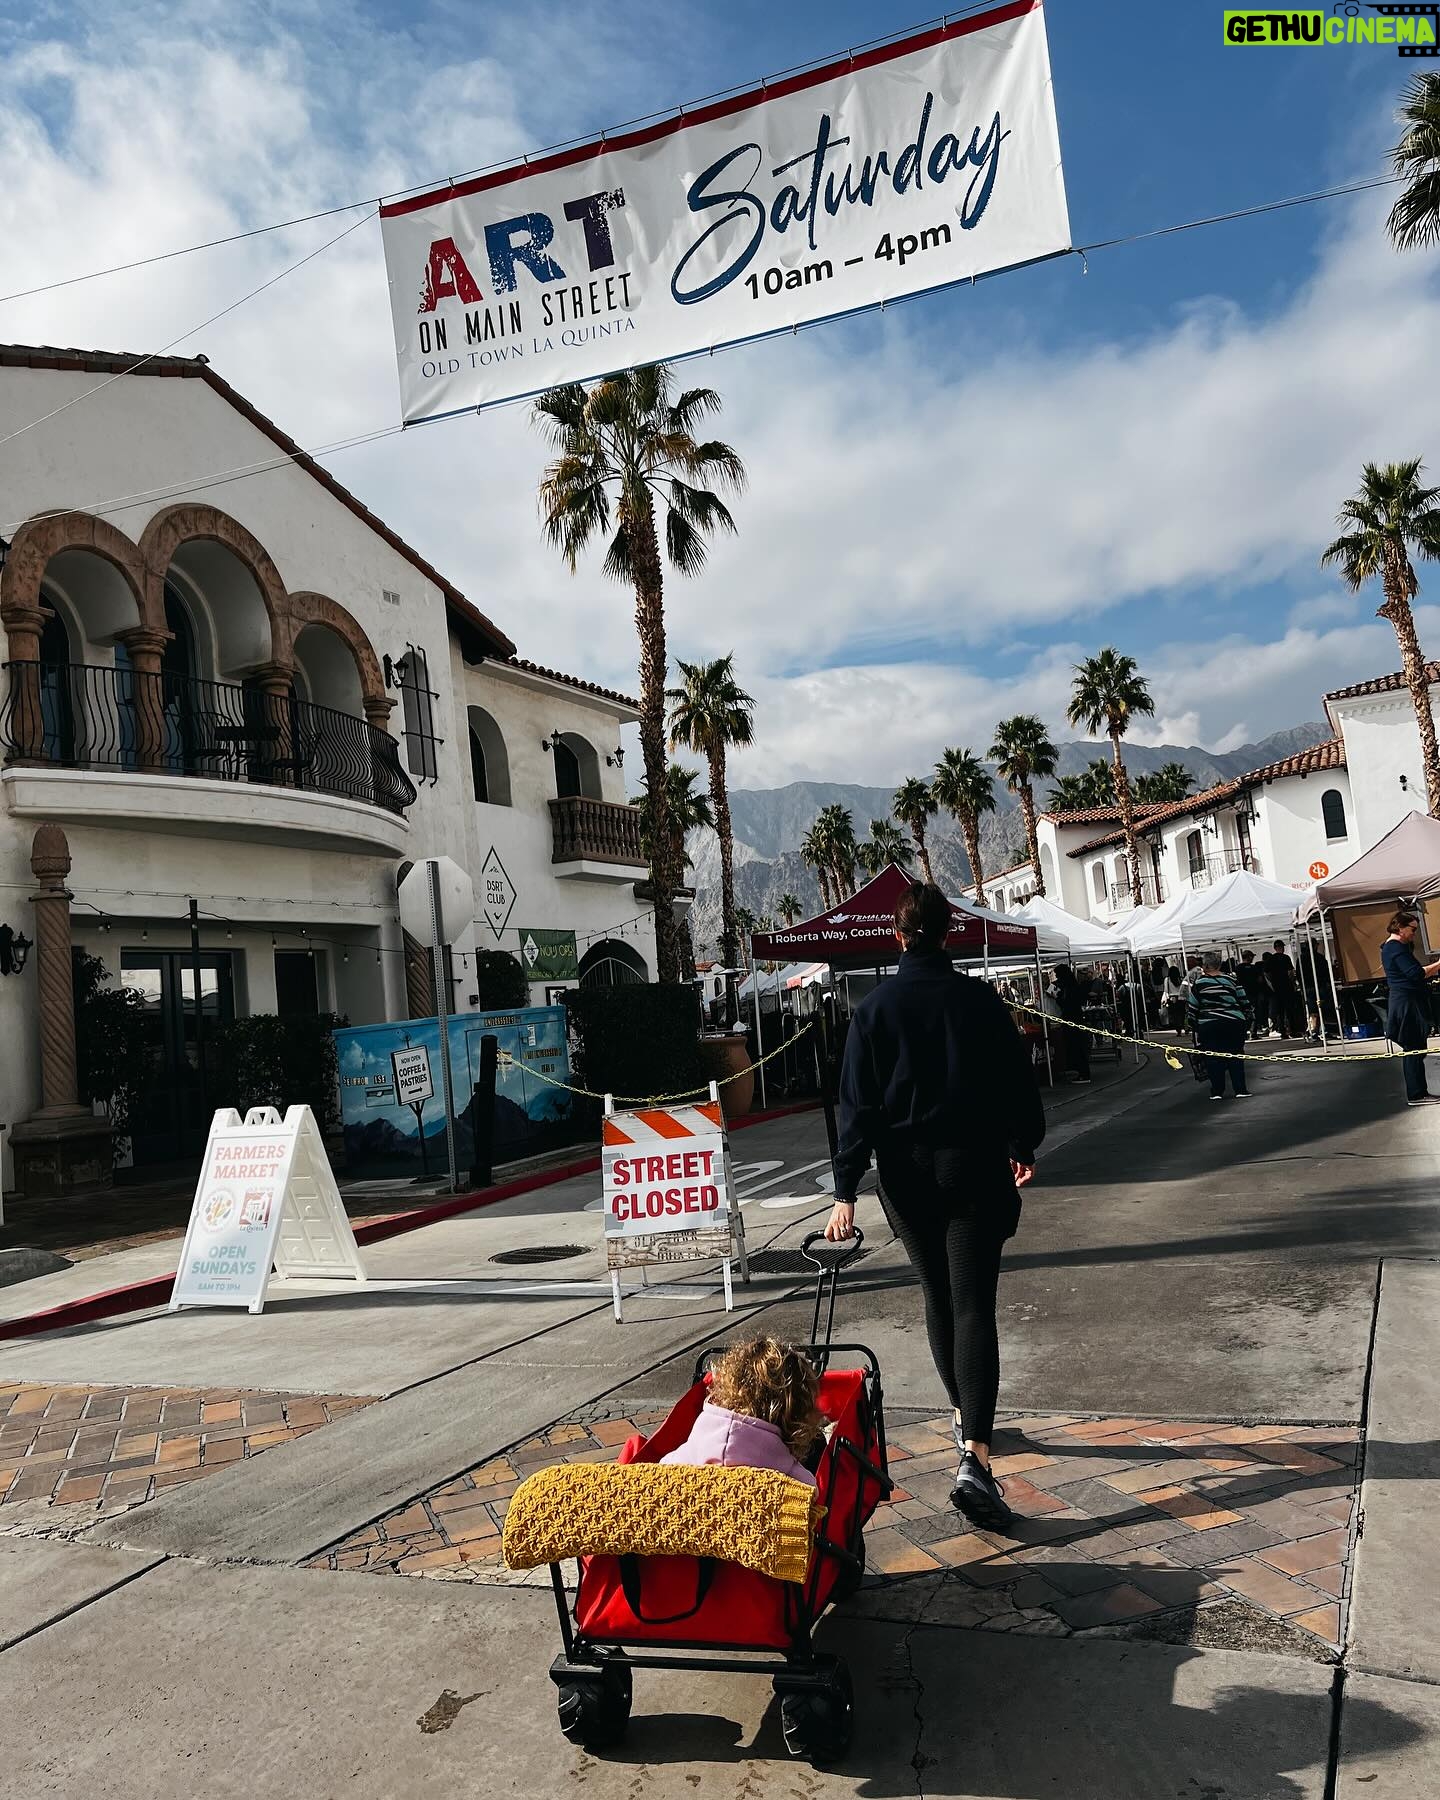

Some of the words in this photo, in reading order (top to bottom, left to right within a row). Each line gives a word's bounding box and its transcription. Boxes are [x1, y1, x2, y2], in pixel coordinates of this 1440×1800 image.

[670, 91, 1012, 305] Saturday
[418, 187, 626, 314] ART
[744, 259, 833, 300] 10am
[874, 223, 951, 266] 4pm
[418, 317, 448, 354] ON
[465, 301, 522, 345] MAIN
[541, 272, 632, 327] STREET
[486, 879, 503, 892] DSRT
[486, 893, 505, 905] CLUB
[768, 935, 773, 944] 1
[775, 932, 819, 944] Roberta
[821, 930, 848, 943] Way,
[411, 1054, 421, 1062] OPEN
[398, 1064, 421, 1078] COFFEE
[422, 1063, 426, 1072] &
[400, 1073, 427, 1088] PASTRIES
[215, 1144, 286, 1160] FARMERS
[213, 1163, 279, 1179] MARKET
[613, 1150, 715, 1186] STREET
[612, 1184, 719, 1221] CLOSED
[208, 1245, 247, 1258] OPEN
[191, 1261, 257, 1275] SUNDAYS
